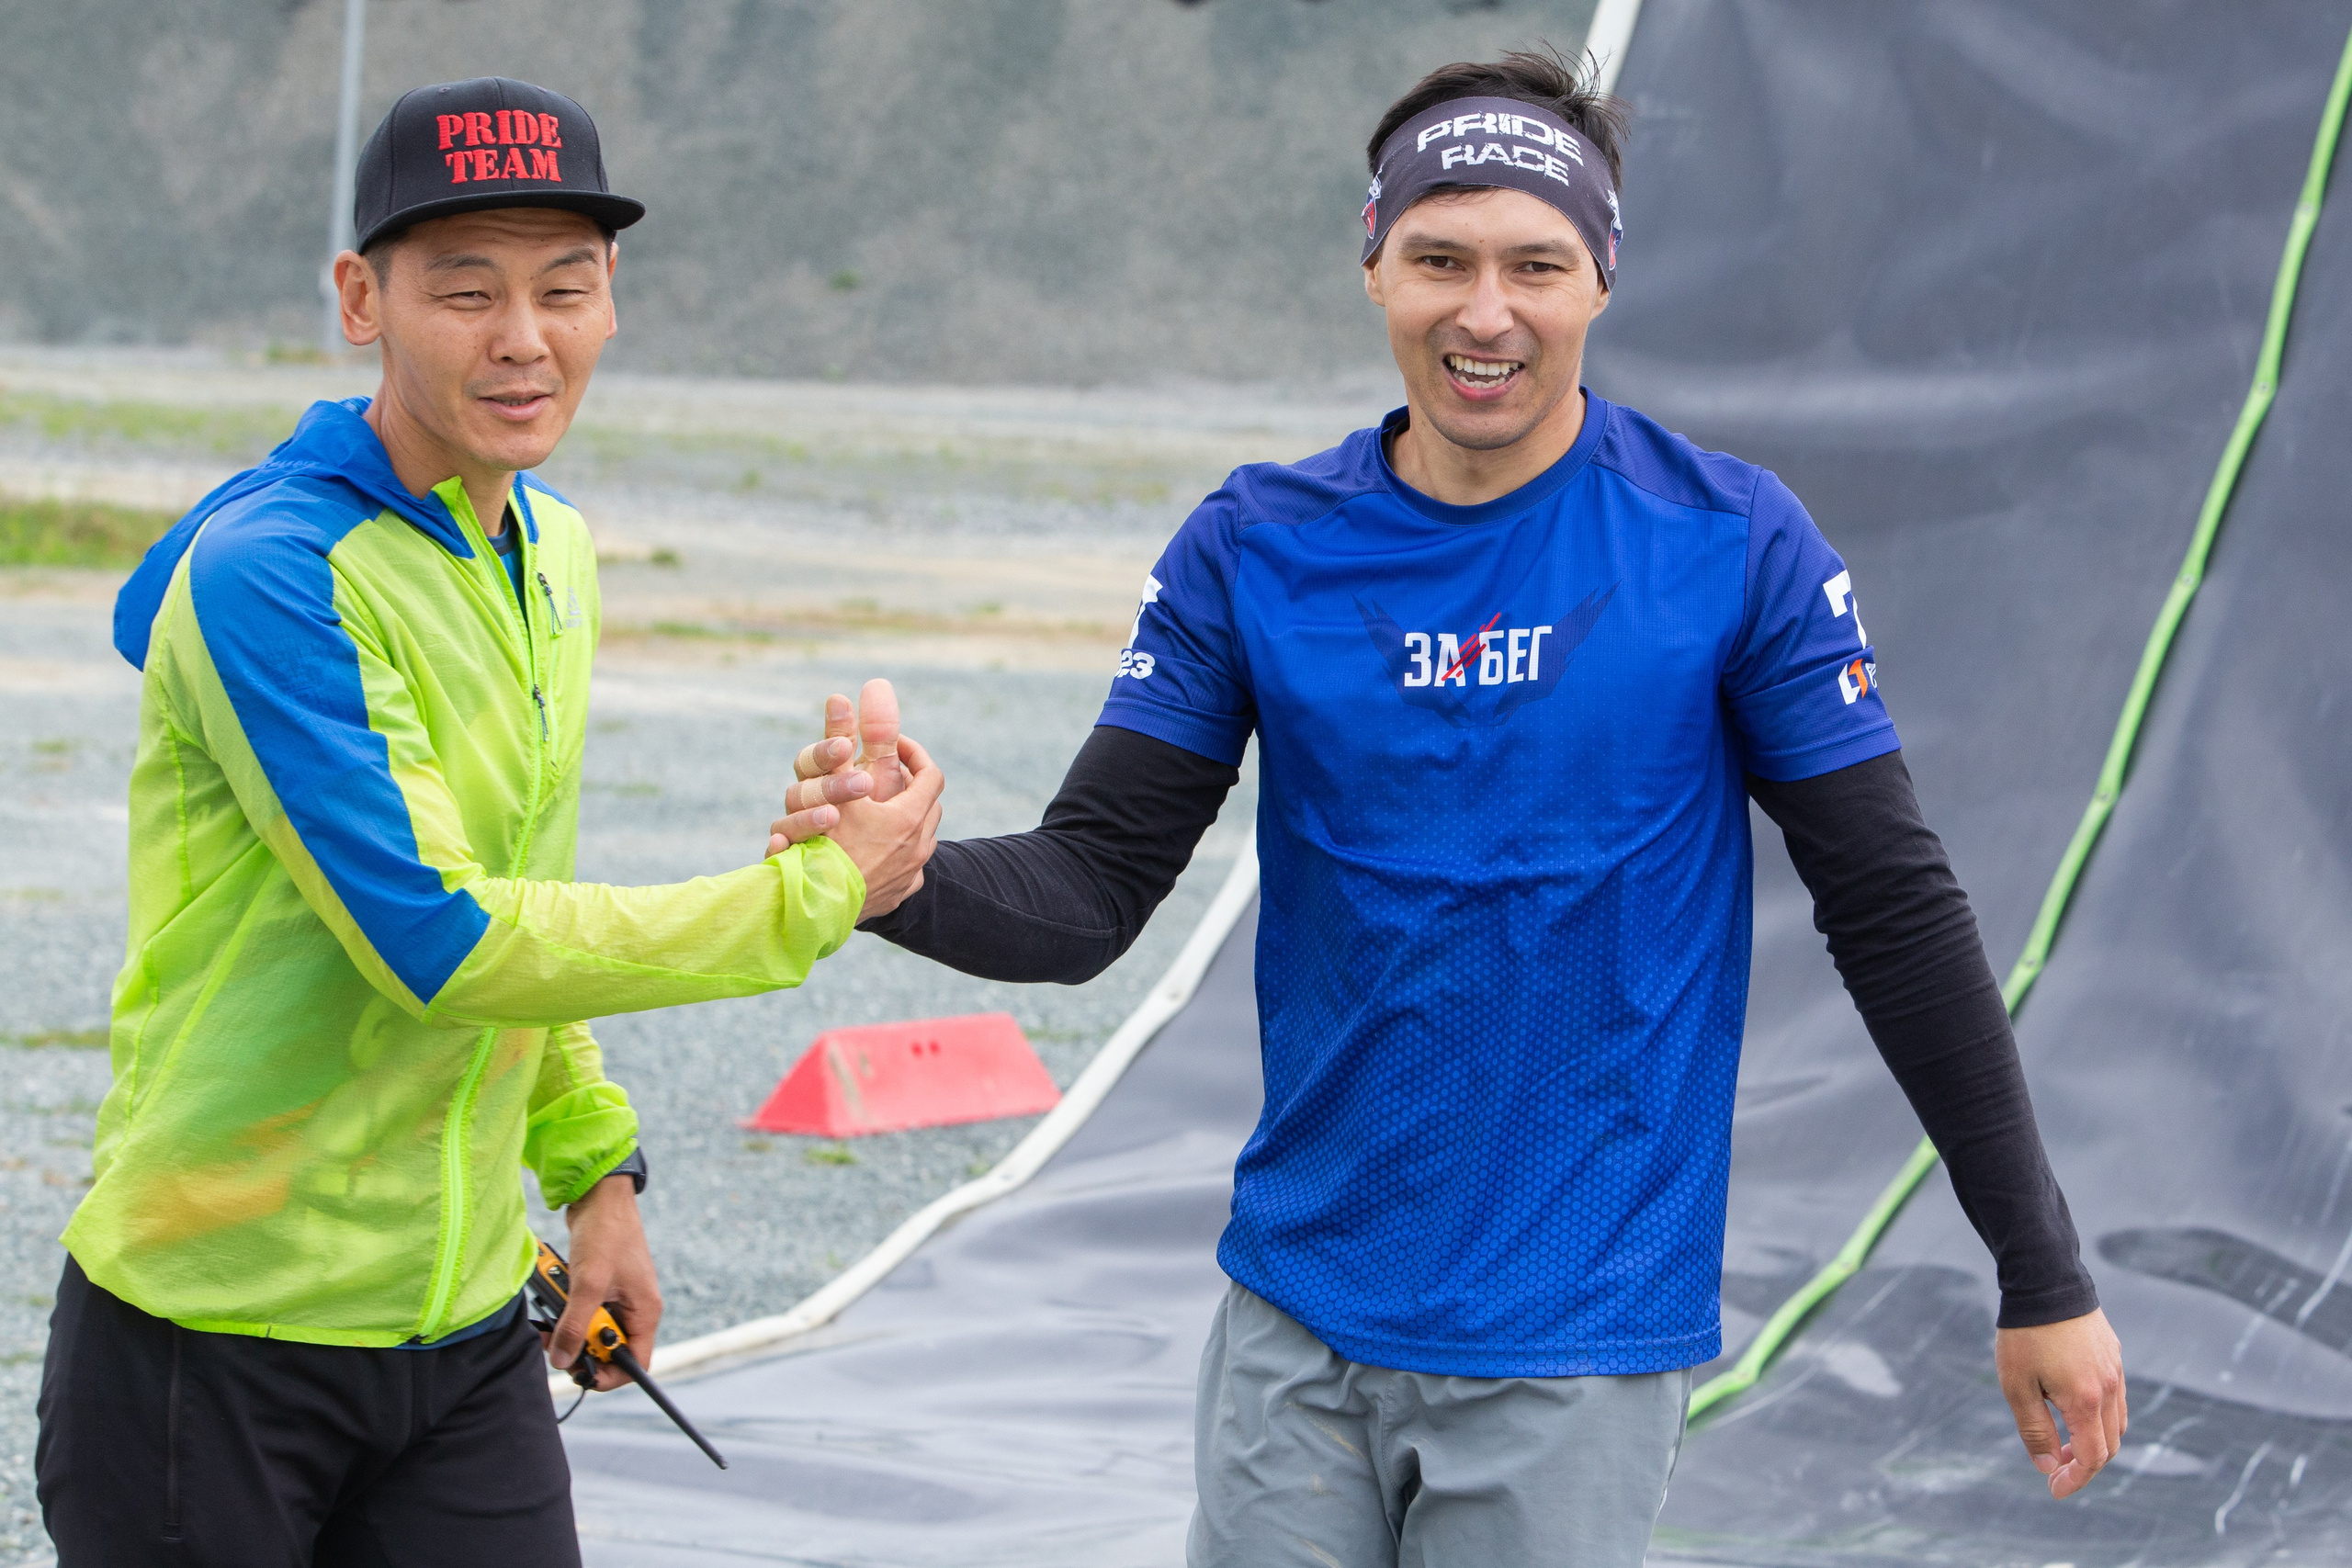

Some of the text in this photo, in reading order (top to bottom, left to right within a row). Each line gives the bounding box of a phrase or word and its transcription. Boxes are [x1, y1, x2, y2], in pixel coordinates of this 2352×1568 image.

[435, 109, 562, 150] PRIDE
[1417, 111, 1584, 166] PRIDE
[445, 147, 562, 184] TEAM
[1441, 142, 1569, 186] RACE
